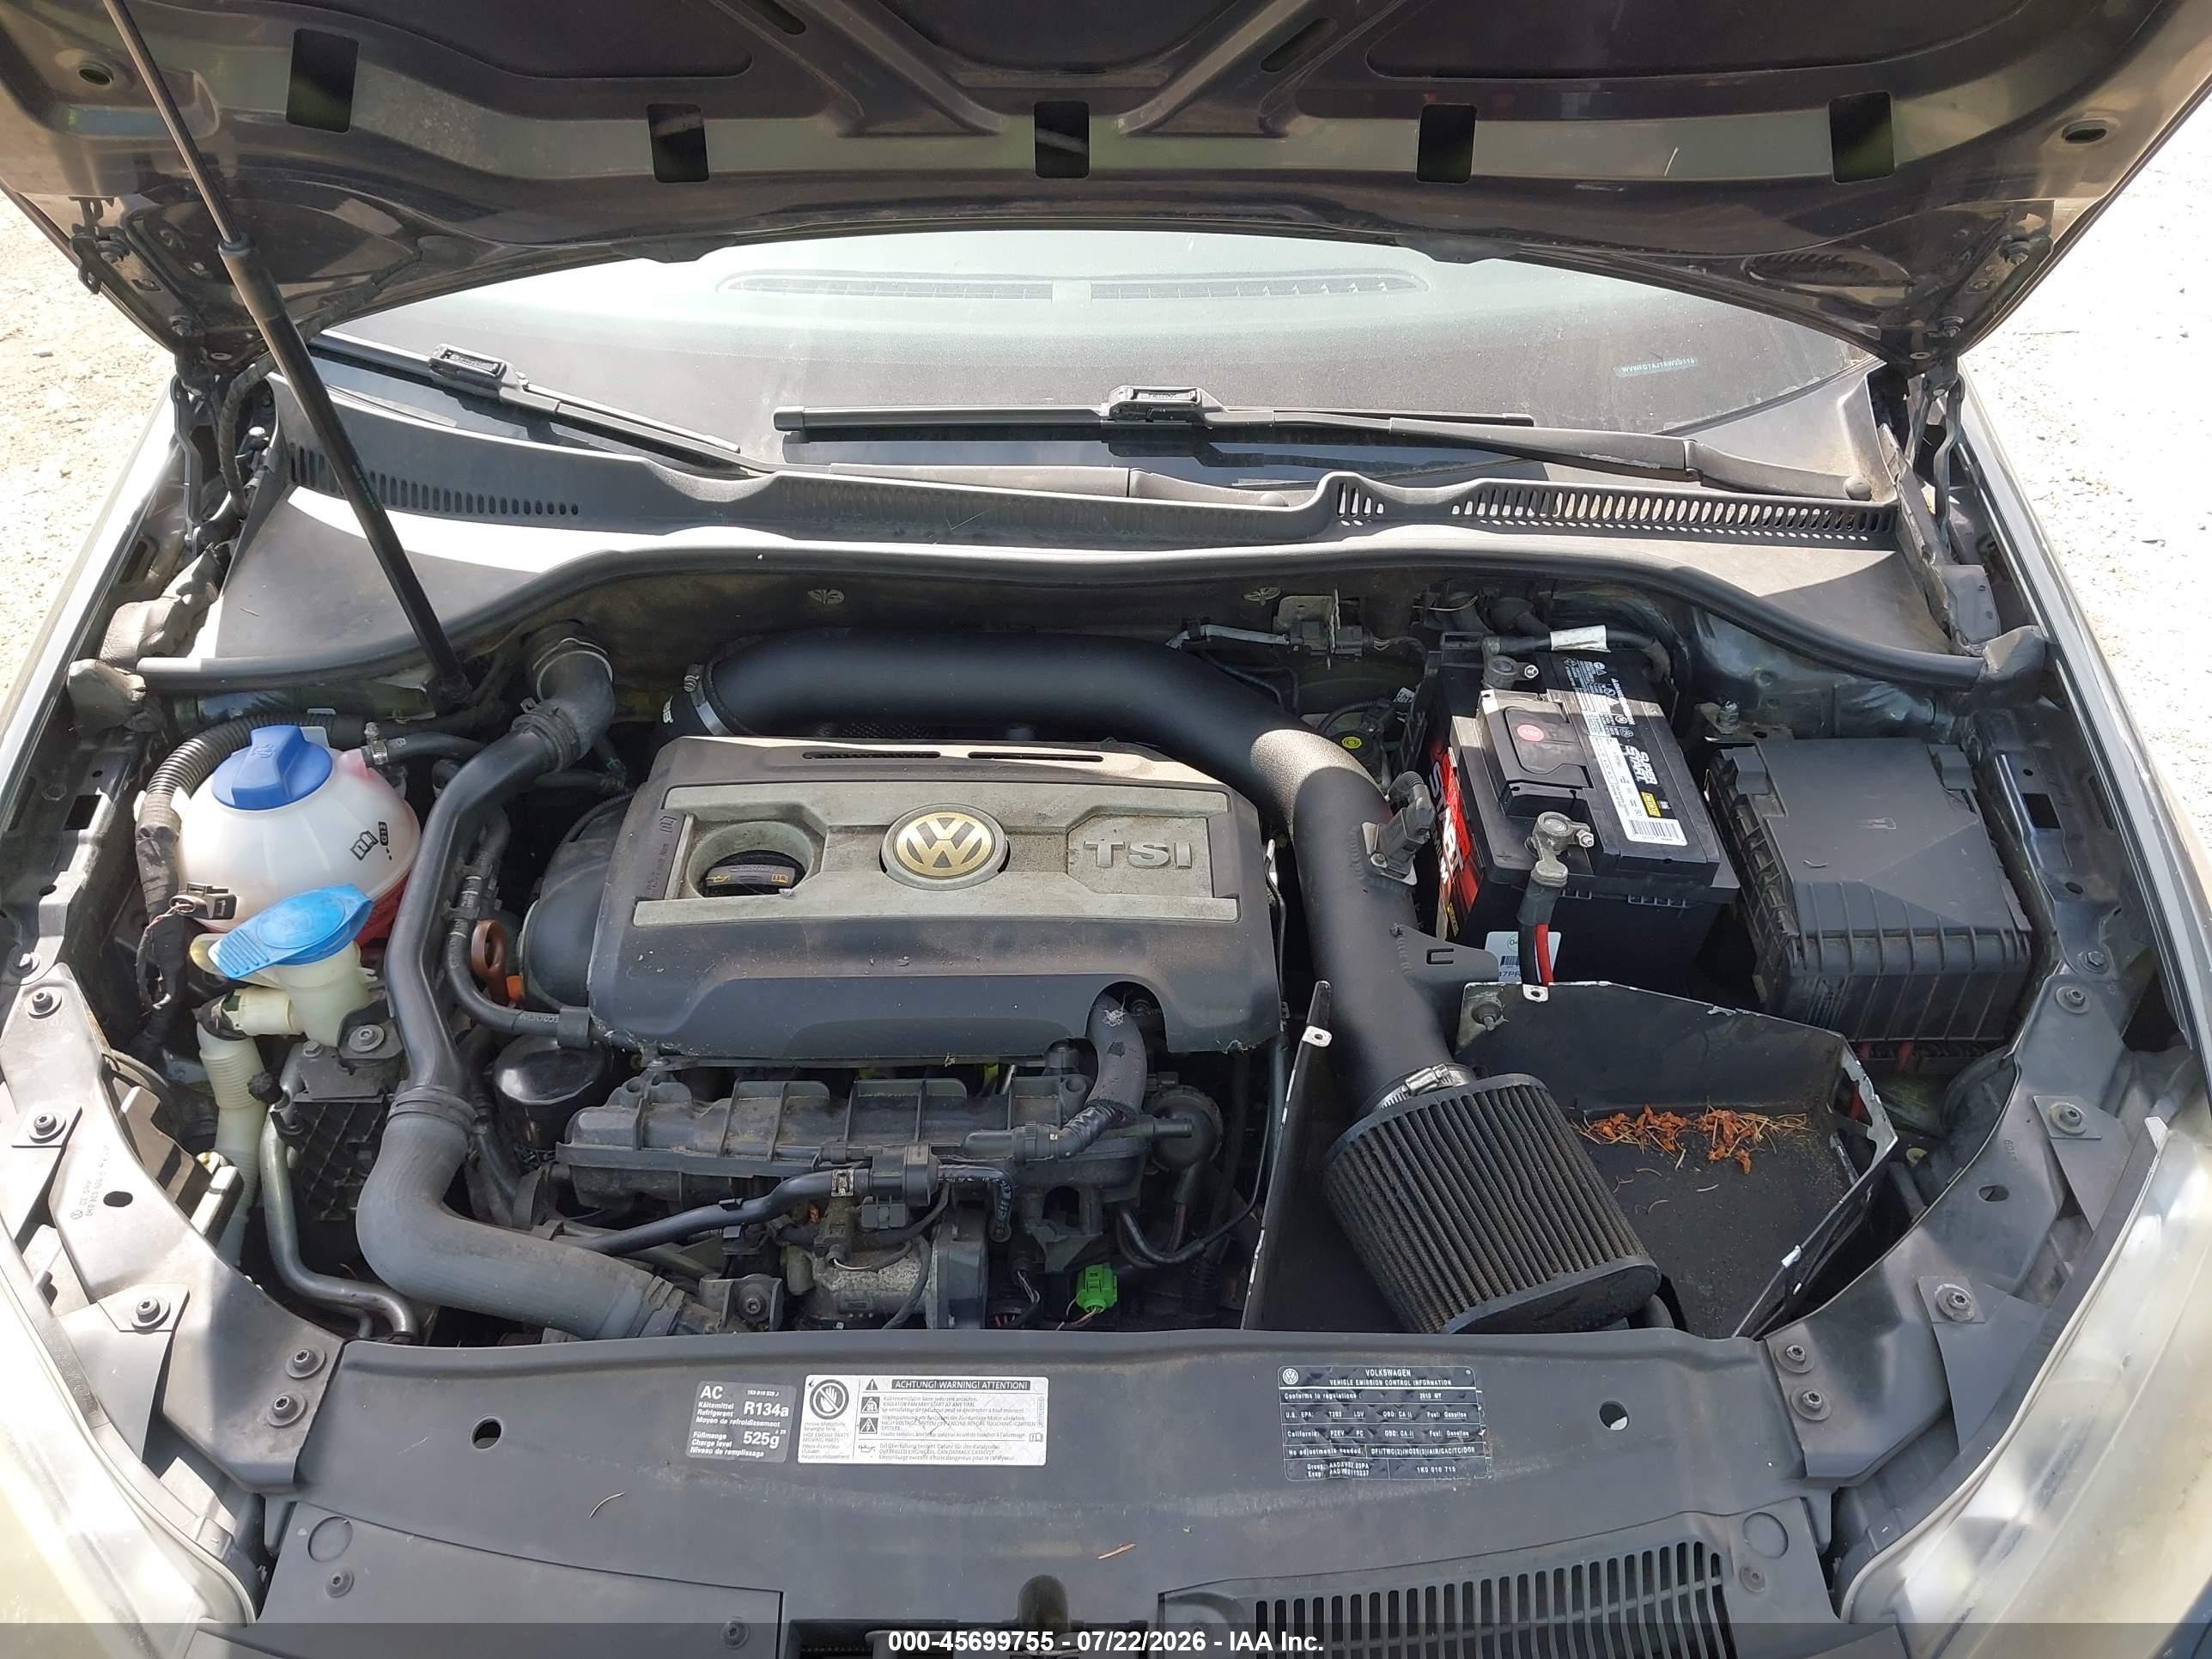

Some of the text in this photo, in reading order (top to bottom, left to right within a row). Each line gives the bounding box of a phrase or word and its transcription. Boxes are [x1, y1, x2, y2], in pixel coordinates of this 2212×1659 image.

[1084, 841, 1193, 869] TSI
[1365, 1369, 1411, 1377] VOLKSWAGEN
[895, 1380, 1028, 1389] ACHTUNG! WARNING! ATTENTION!
[700, 1385, 723, 1400] AC
[696, 1409, 734, 1418] Refrigerant
[743, 1401, 789, 1417] R134a
[729, 1418, 781, 1427] refroidissement
[692, 1431, 727, 1441] Füllmenge
[743, 1431, 780, 1449] 525g
[724, 1448, 764, 1458] remplissage
[1299, 1448, 1337, 1456] adjustments
